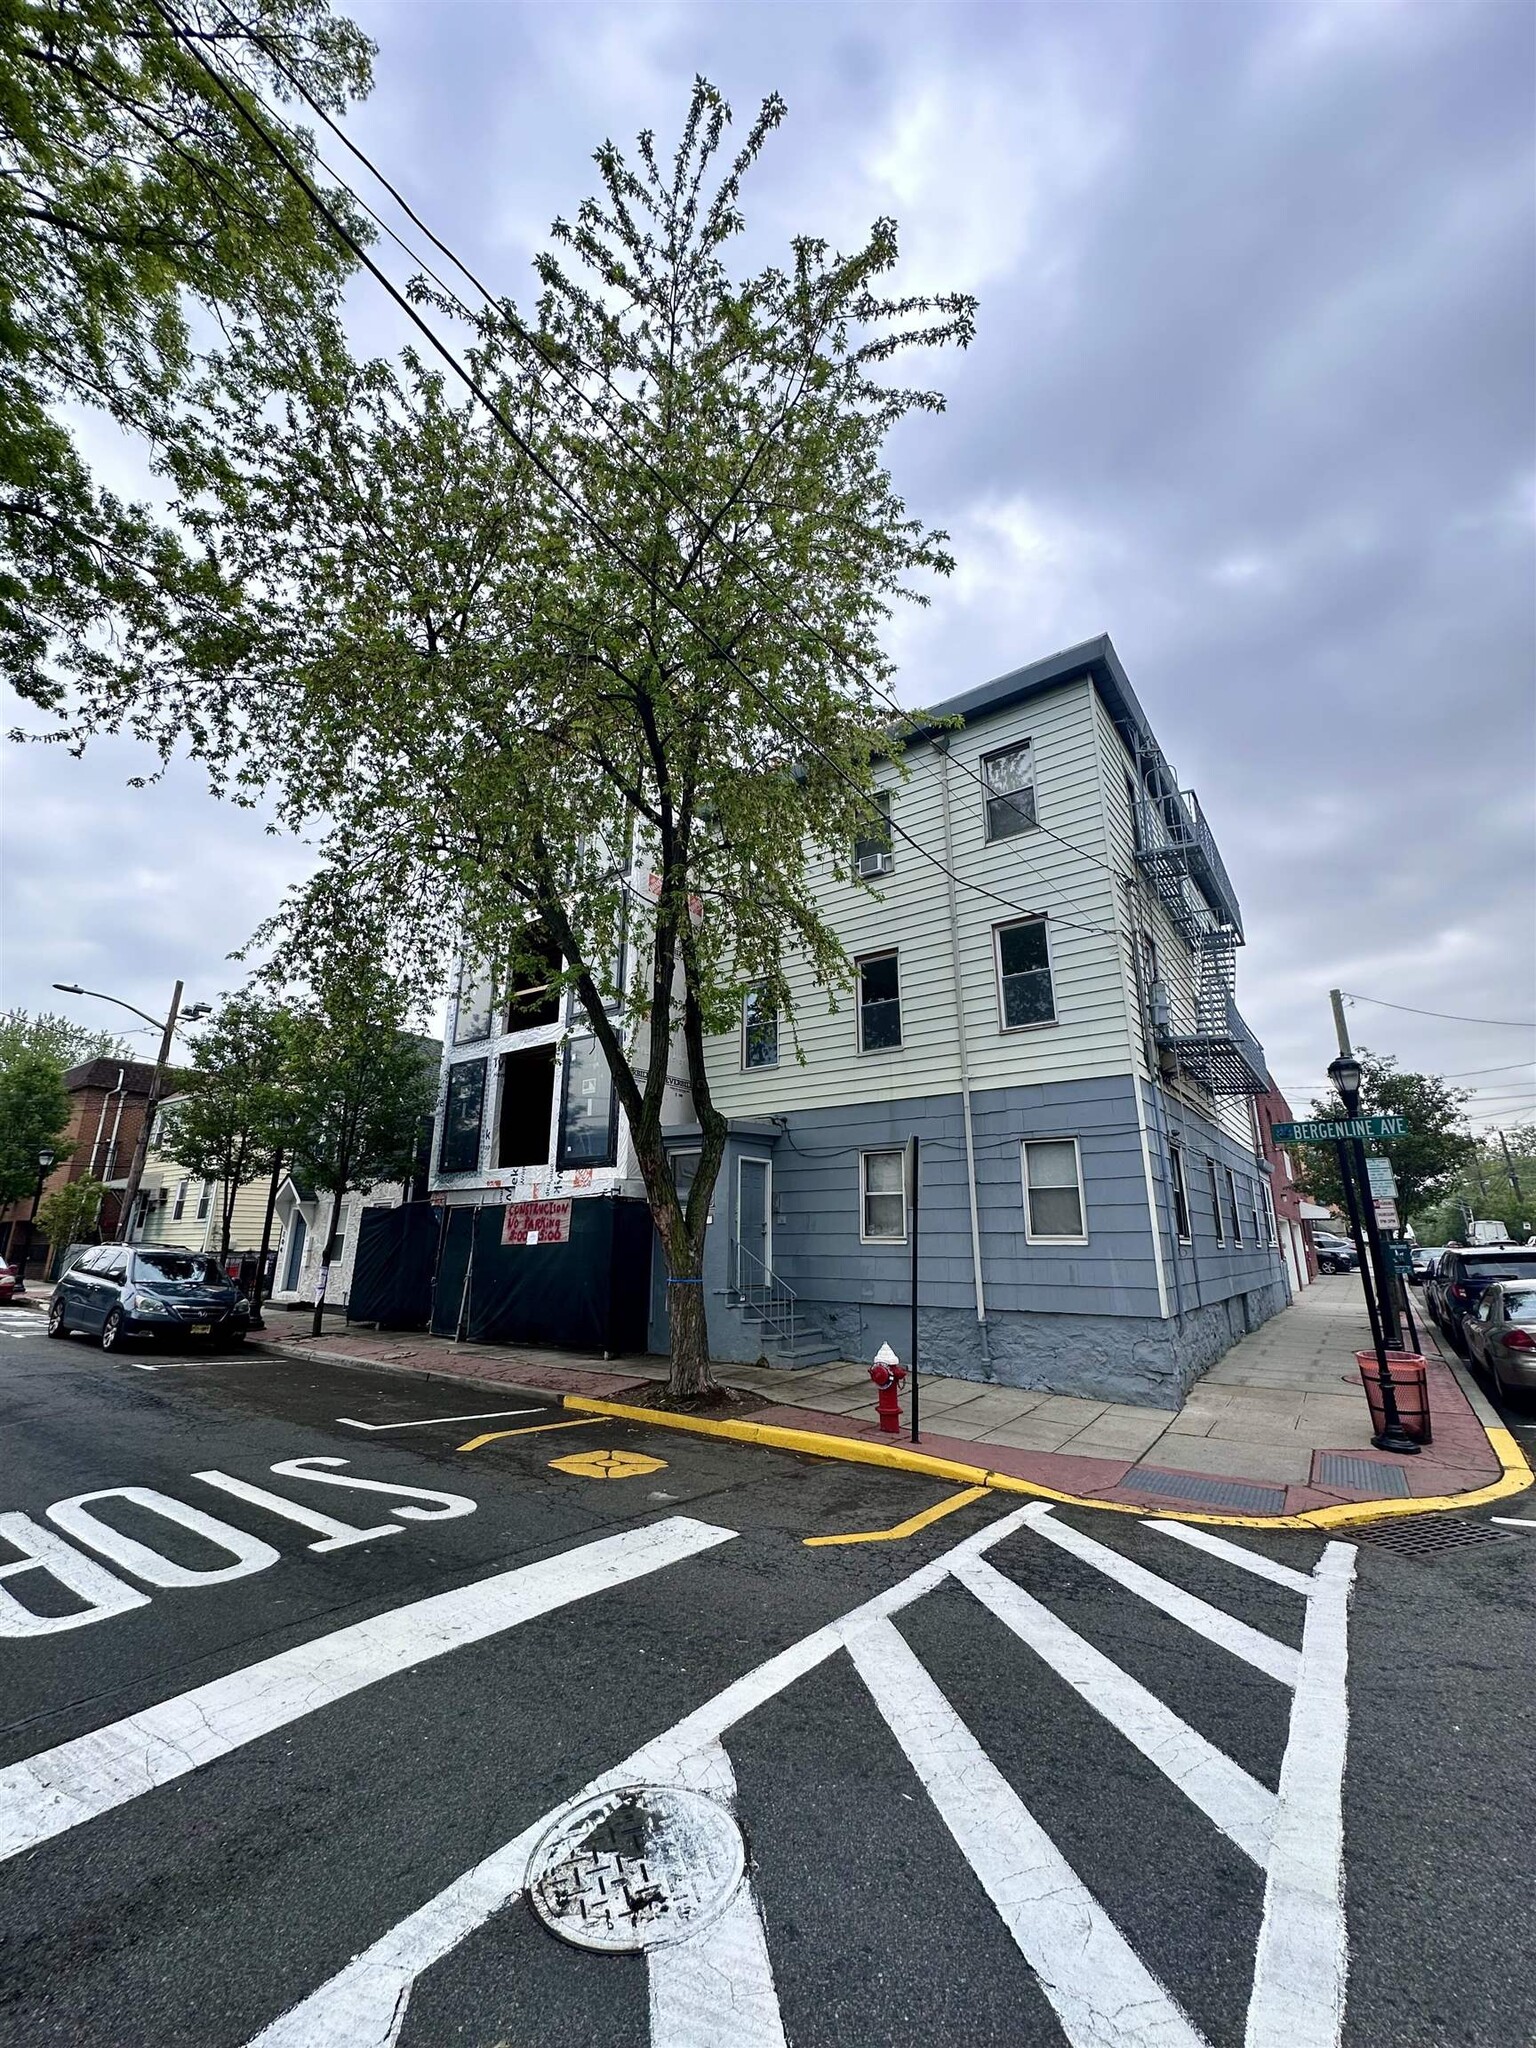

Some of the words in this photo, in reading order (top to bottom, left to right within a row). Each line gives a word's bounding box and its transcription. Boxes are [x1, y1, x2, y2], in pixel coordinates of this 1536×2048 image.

[1293, 1120, 1375, 1140] BERGENLINE
[1380, 1118, 1406, 1135] AVE
[508, 1202, 569, 1217] CONSTRUCTION
[507, 1217, 519, 1229] NO
[0, 1456, 478, 1638] STOP
